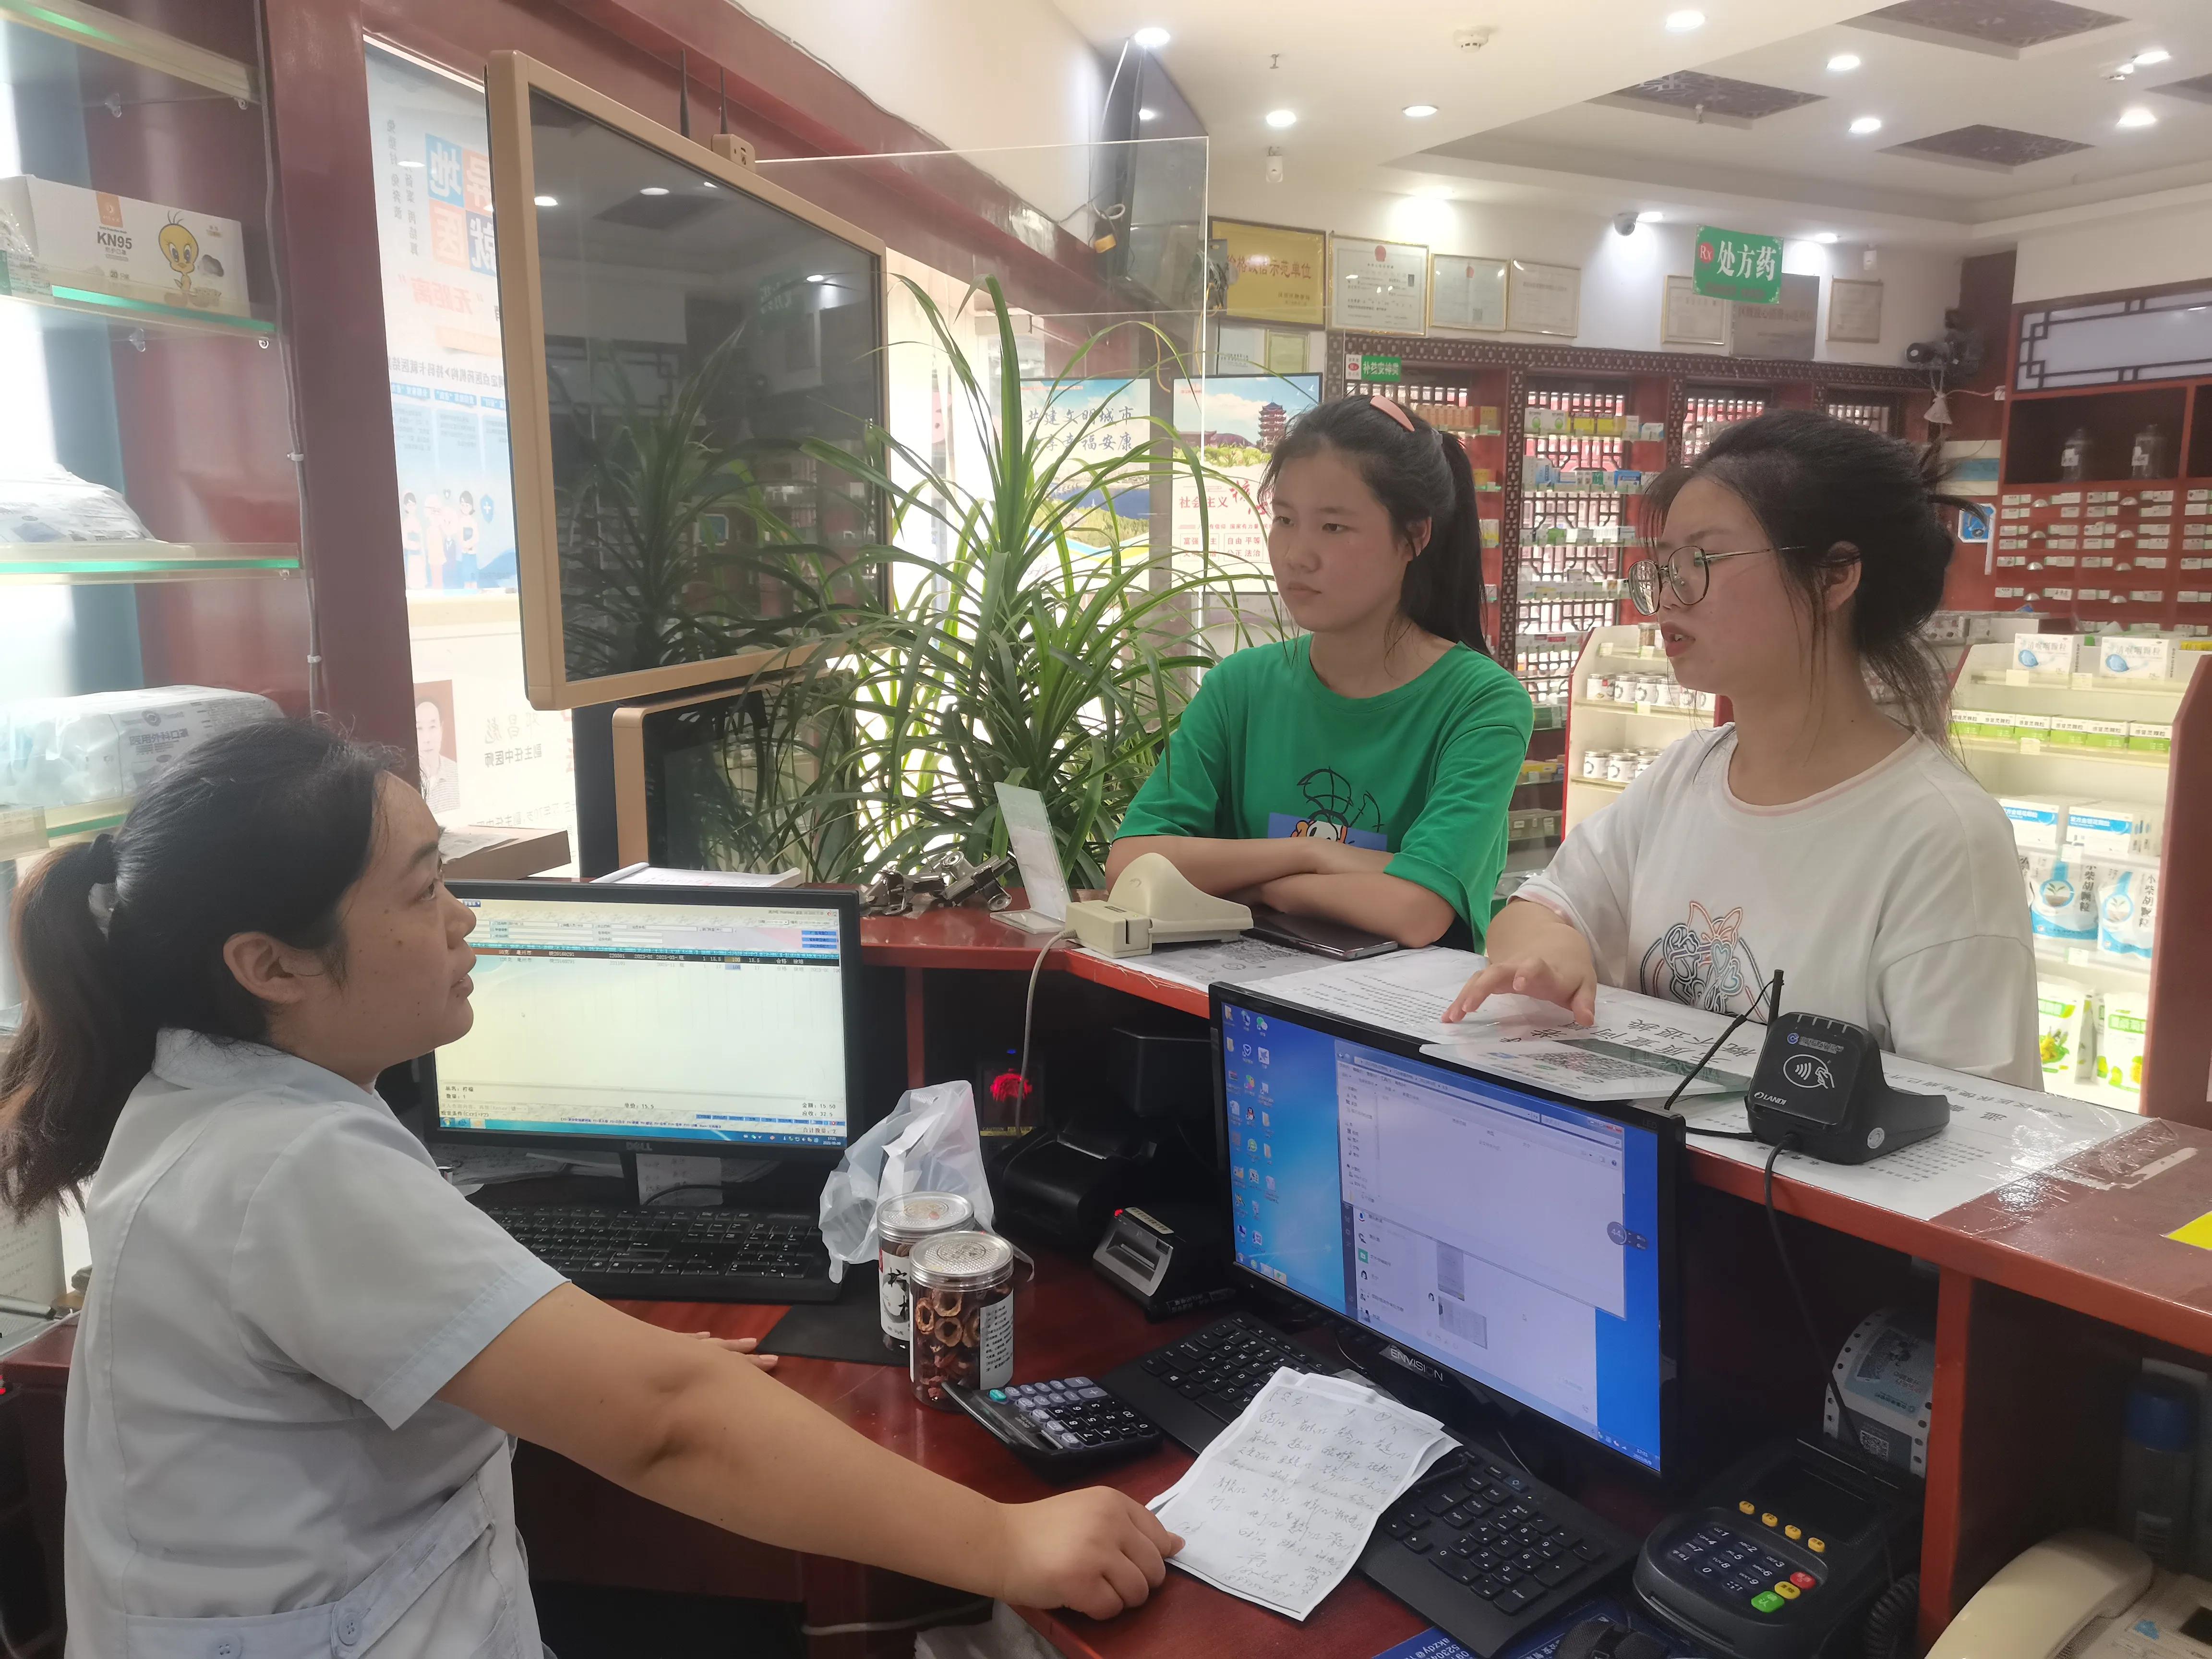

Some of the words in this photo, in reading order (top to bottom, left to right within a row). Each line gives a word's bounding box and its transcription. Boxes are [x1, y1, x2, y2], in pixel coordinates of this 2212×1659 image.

[96, 231, 132, 250] KN95
[1699, 245, 1712, 261] Rx
[1717, 240, 1776, 281] 处方药
[1025, 406, 1133, 425] 共建文明城市
[1034, 432, 1132, 451] 享幸福安康
[1179, 496, 1228, 508] 社会主义
[1227, 537, 1242, 545] 自由
[1245, 537, 1261, 545] 平等
[1245, 549, 1261, 557] 法治
[2056, 722, 2083, 730] 感冒灵颗粒
[2092, 725, 2121, 734] 感冒灵颗粒
[2135, 729, 2166, 737] 感冒灵颗粒
[130, 728, 189, 745] 医用外科口罩
[2080, 865, 2097, 912] 小柴胡颗粒
[2139, 874, 2156, 928] 小柴胡颗粒
[1628, 1018, 1757, 1057] 概不退换
[1764, 1094, 1787, 1105] LANDI
[626, 1142, 652, 1151] DELL
[1390, 1348, 1443, 1382] ENVISION
[1512, 1589, 1525, 1599] Enter
